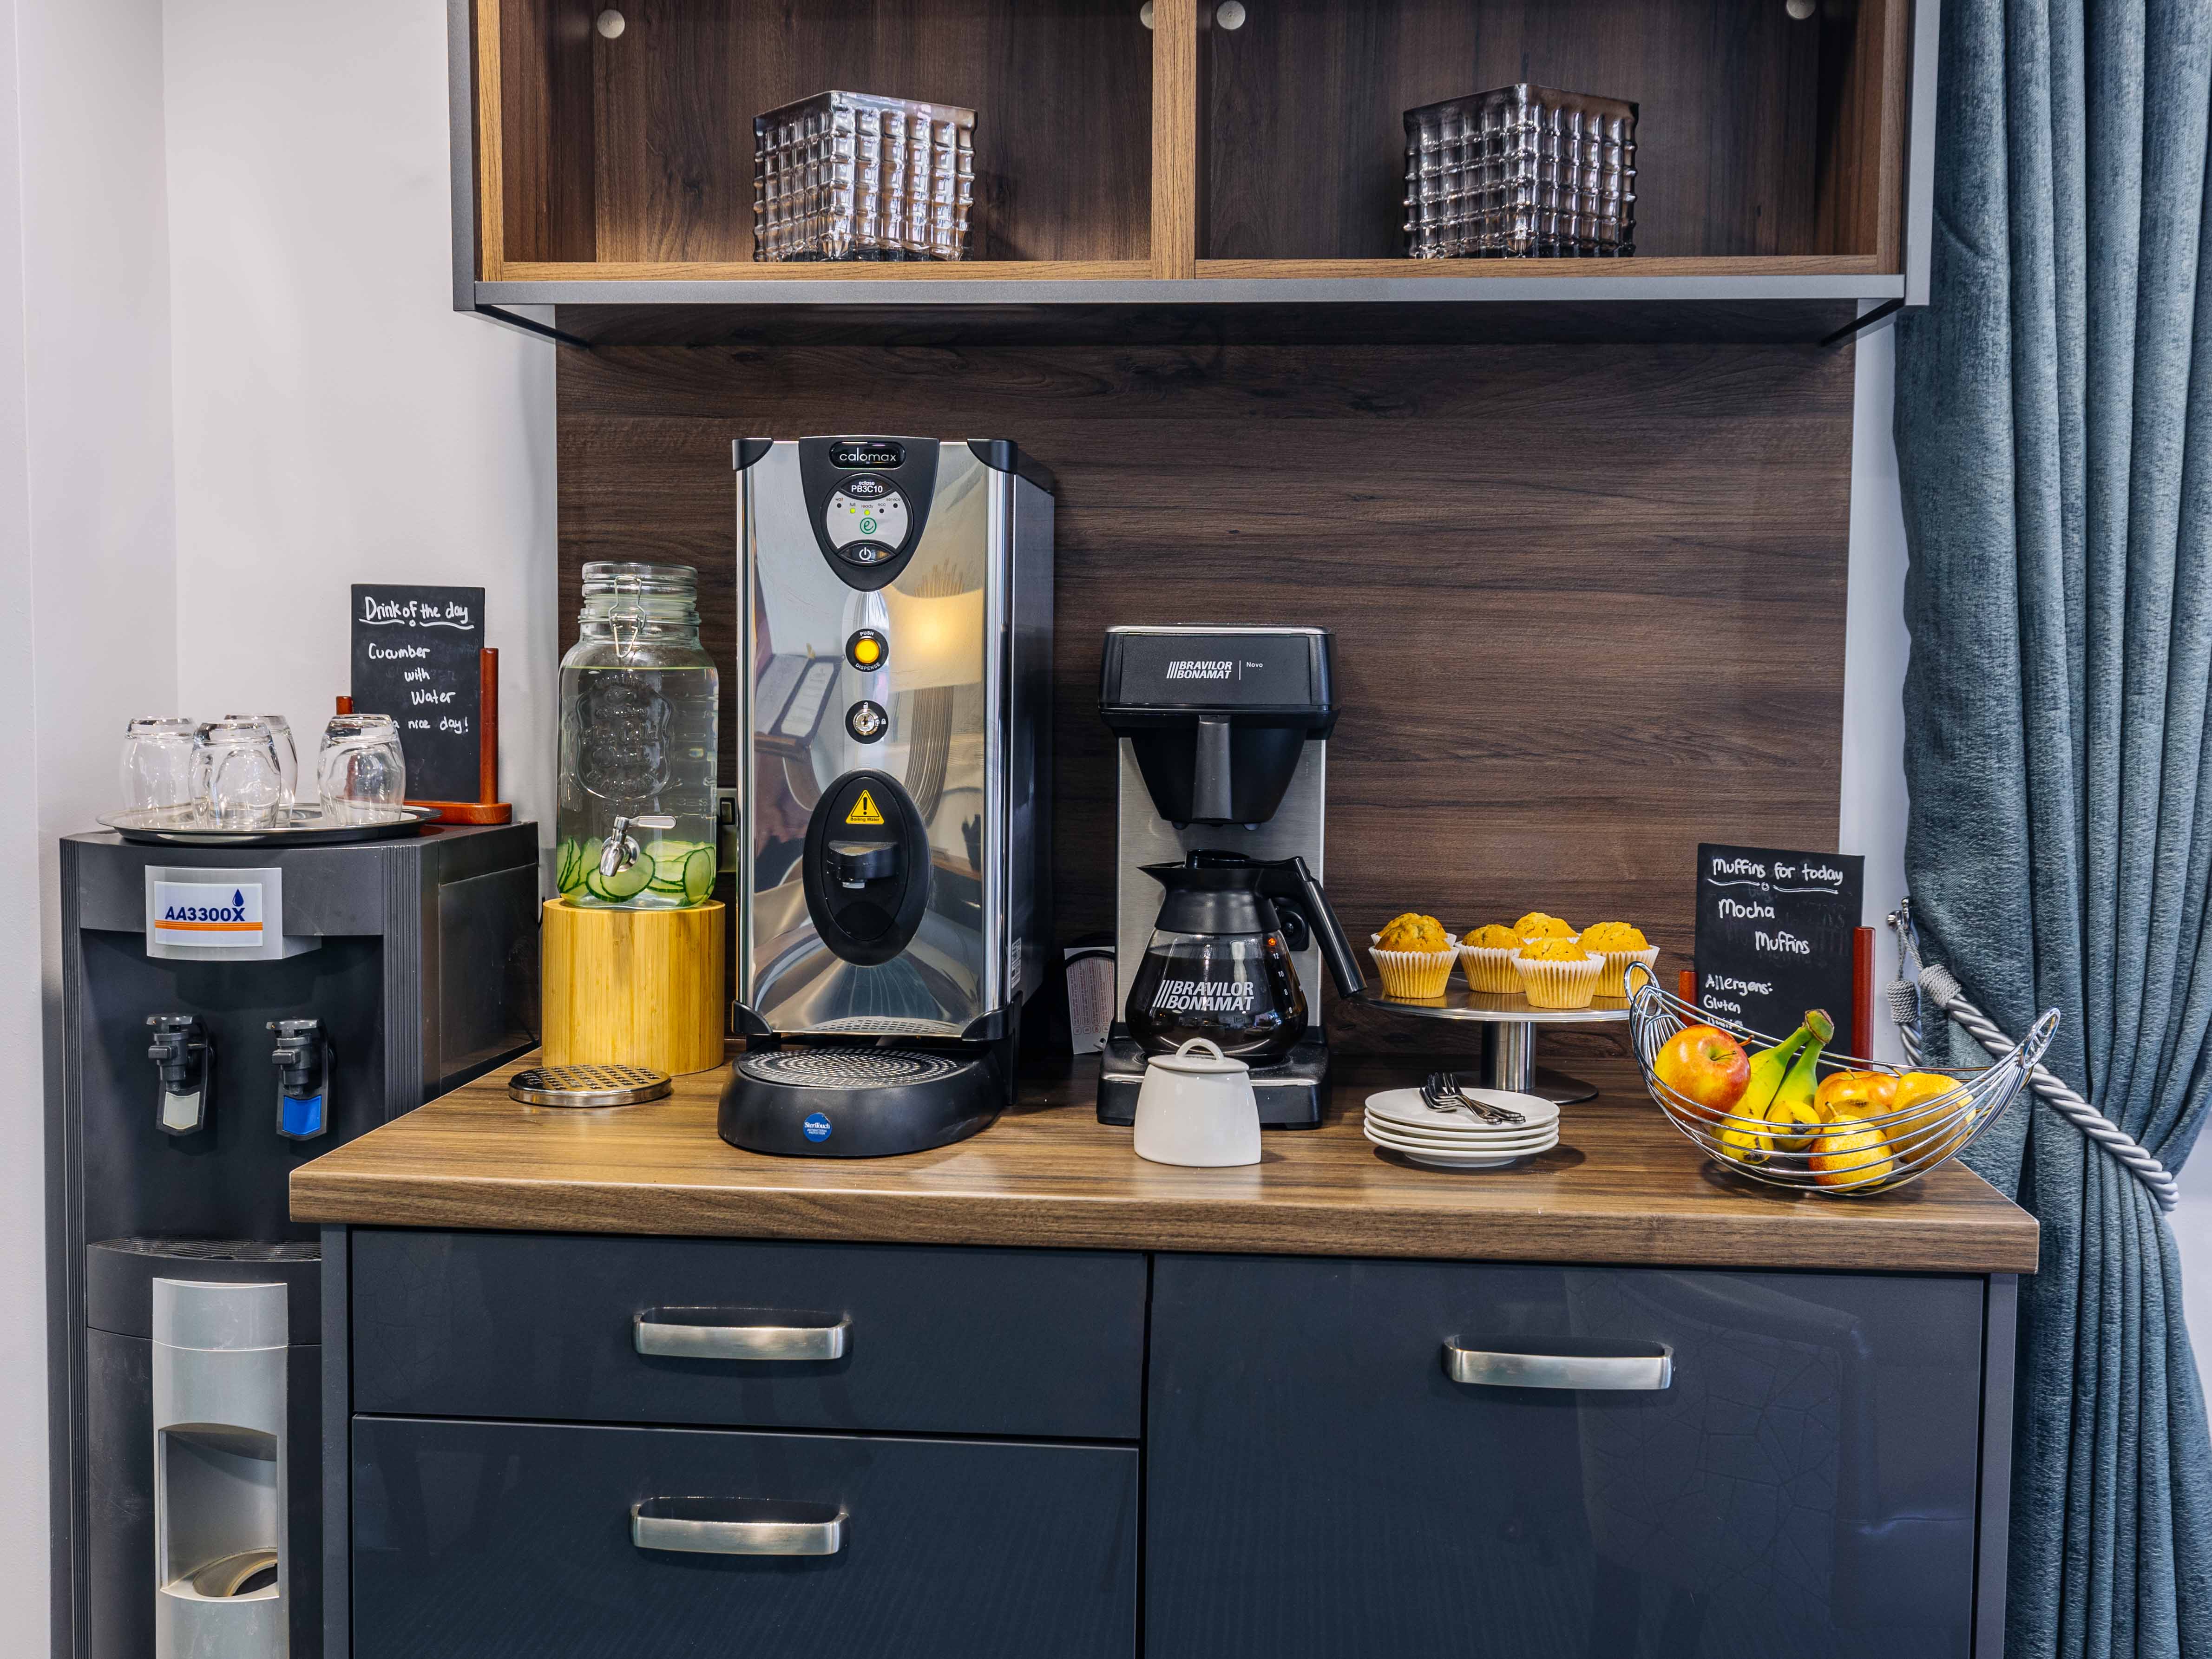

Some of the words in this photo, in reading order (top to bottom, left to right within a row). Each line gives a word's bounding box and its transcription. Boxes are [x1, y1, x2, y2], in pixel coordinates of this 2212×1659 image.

[840, 447, 896, 461] calomax
[365, 596, 401, 621] Drink
[402, 601, 417, 618] of
[420, 603, 441, 619] the
[445, 602, 468, 624] day
[1179, 661, 1233, 670] BRAVILOR
[404, 667, 431, 682] with
[1176, 670, 1232, 679] BONAMAT
[411, 689, 456, 705] Water
[408, 720, 431, 729] nice
[440, 715, 469, 734] day!
[1713, 858, 1766, 879] Muffins
[1773, 862, 1796, 879] for
[1801, 864, 1844, 885] today
[164, 906, 246, 922] AA3300X
[1718, 898, 1775, 919] Mocha
[1755, 931, 1811, 954] Muffins
[1171, 981, 1254, 996] BRAVILOR
[1705, 973, 1773, 997] Allergens:
[1167, 996, 1255, 1011] BONAMAT
[1703, 994, 1741, 1014] Gluten
